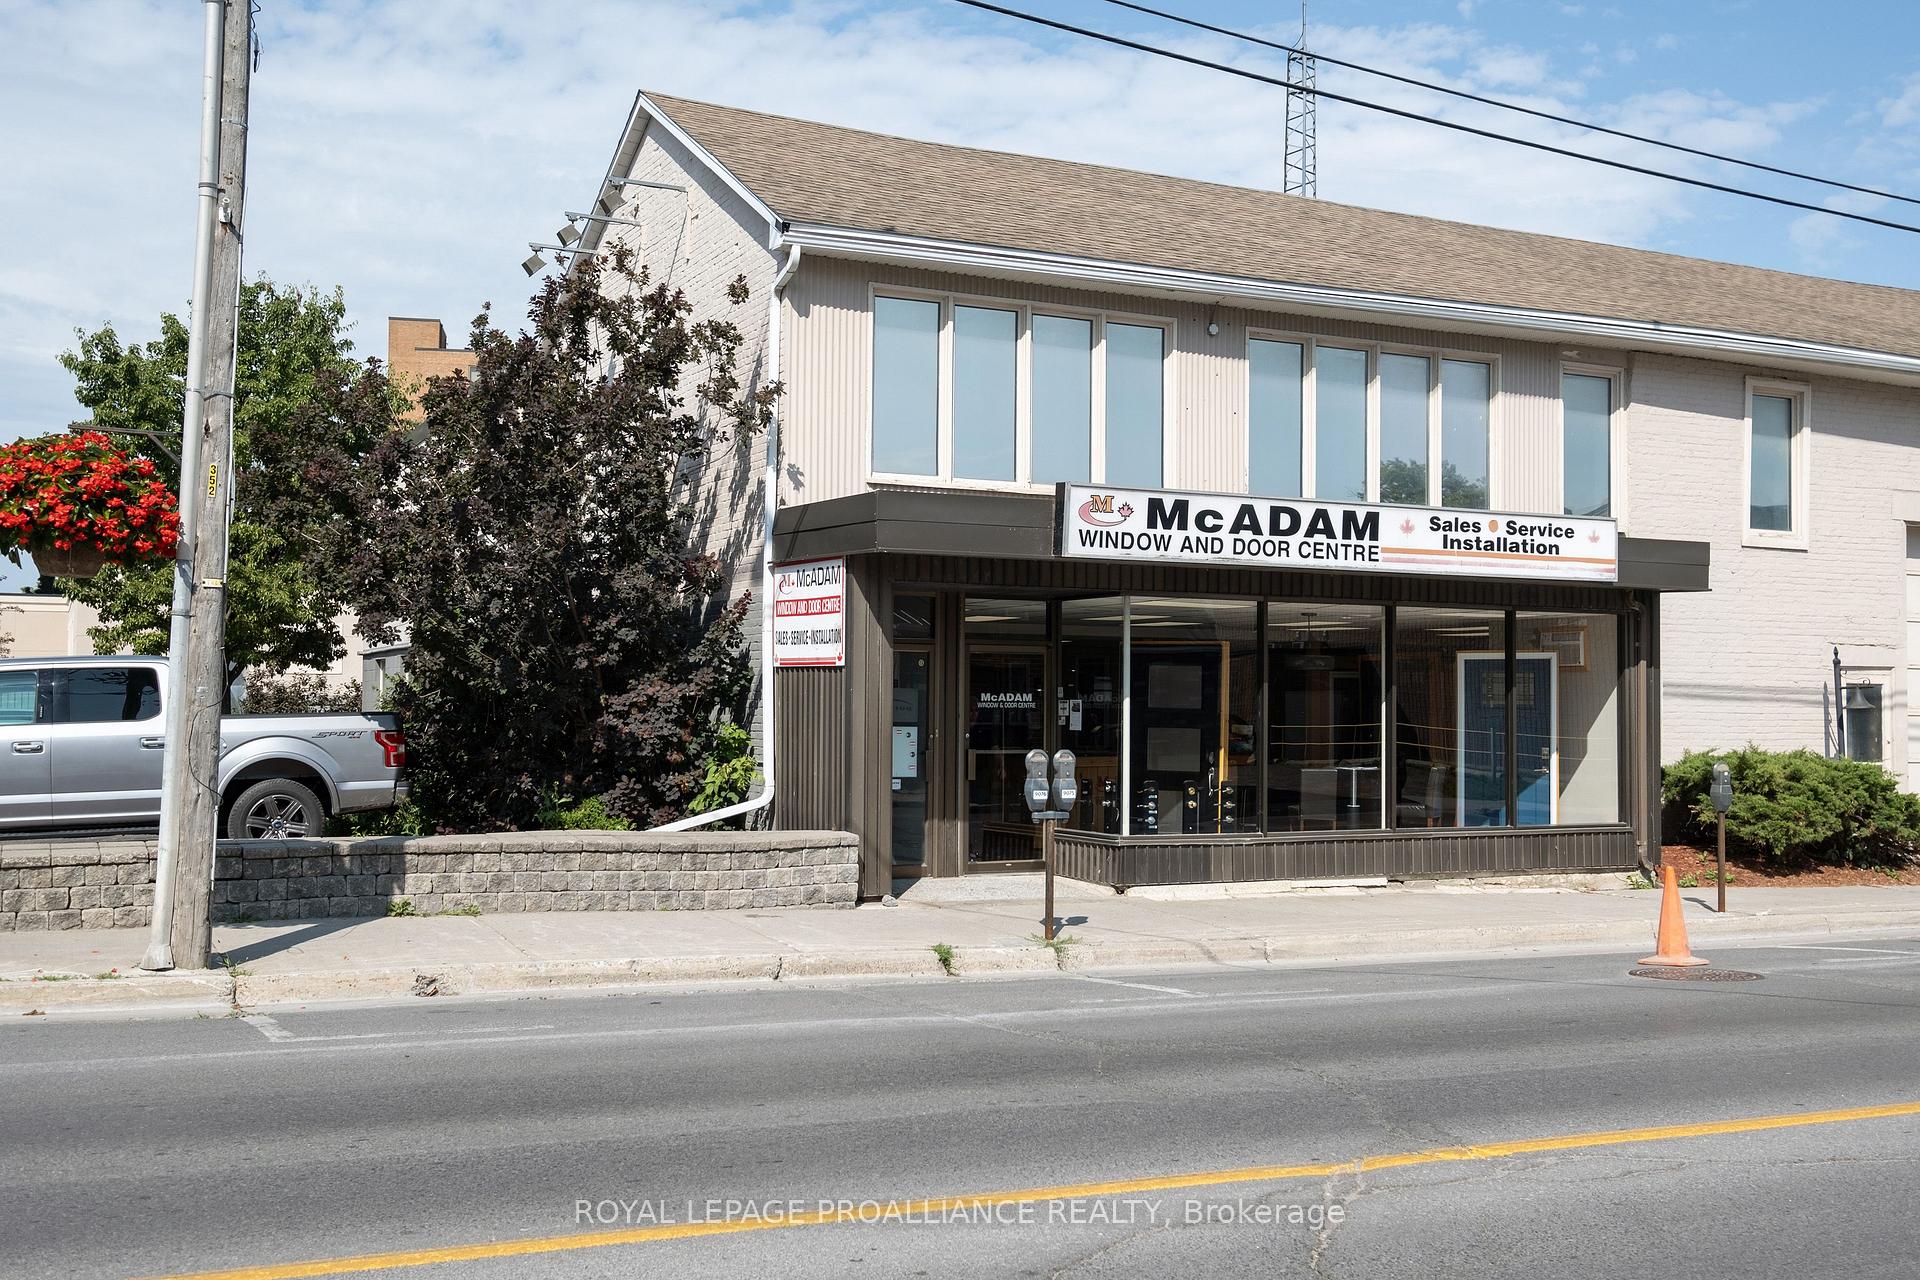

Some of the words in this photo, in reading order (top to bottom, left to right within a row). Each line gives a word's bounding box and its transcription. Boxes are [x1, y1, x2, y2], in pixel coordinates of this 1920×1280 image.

[208, 464, 217, 496] 352
[1090, 494, 1115, 514] M
[1146, 497, 1380, 542] McADAM
[1429, 515, 1482, 533] Sales
[1505, 520, 1575, 539] Service
[1078, 529, 1172, 552] WINDOW
[1180, 535, 1224, 554] AND
[1232, 538, 1290, 557] DOOR
[1298, 541, 1380, 562] CENTRE
[1442, 534, 1560, 556] Installation
[796, 565, 841, 588] McADAM
[777, 601, 798, 615] WINDOW
[797, 600, 808, 614] AND
[808, 599, 822, 613] DOOR
[775, 630, 788, 645] SALES
[790, 630, 809, 645] SERVICE
[810, 628, 841, 645] INSTALLATION
[980, 692, 1033, 702] McADAM
[311, 730, 368, 739] SPORT
